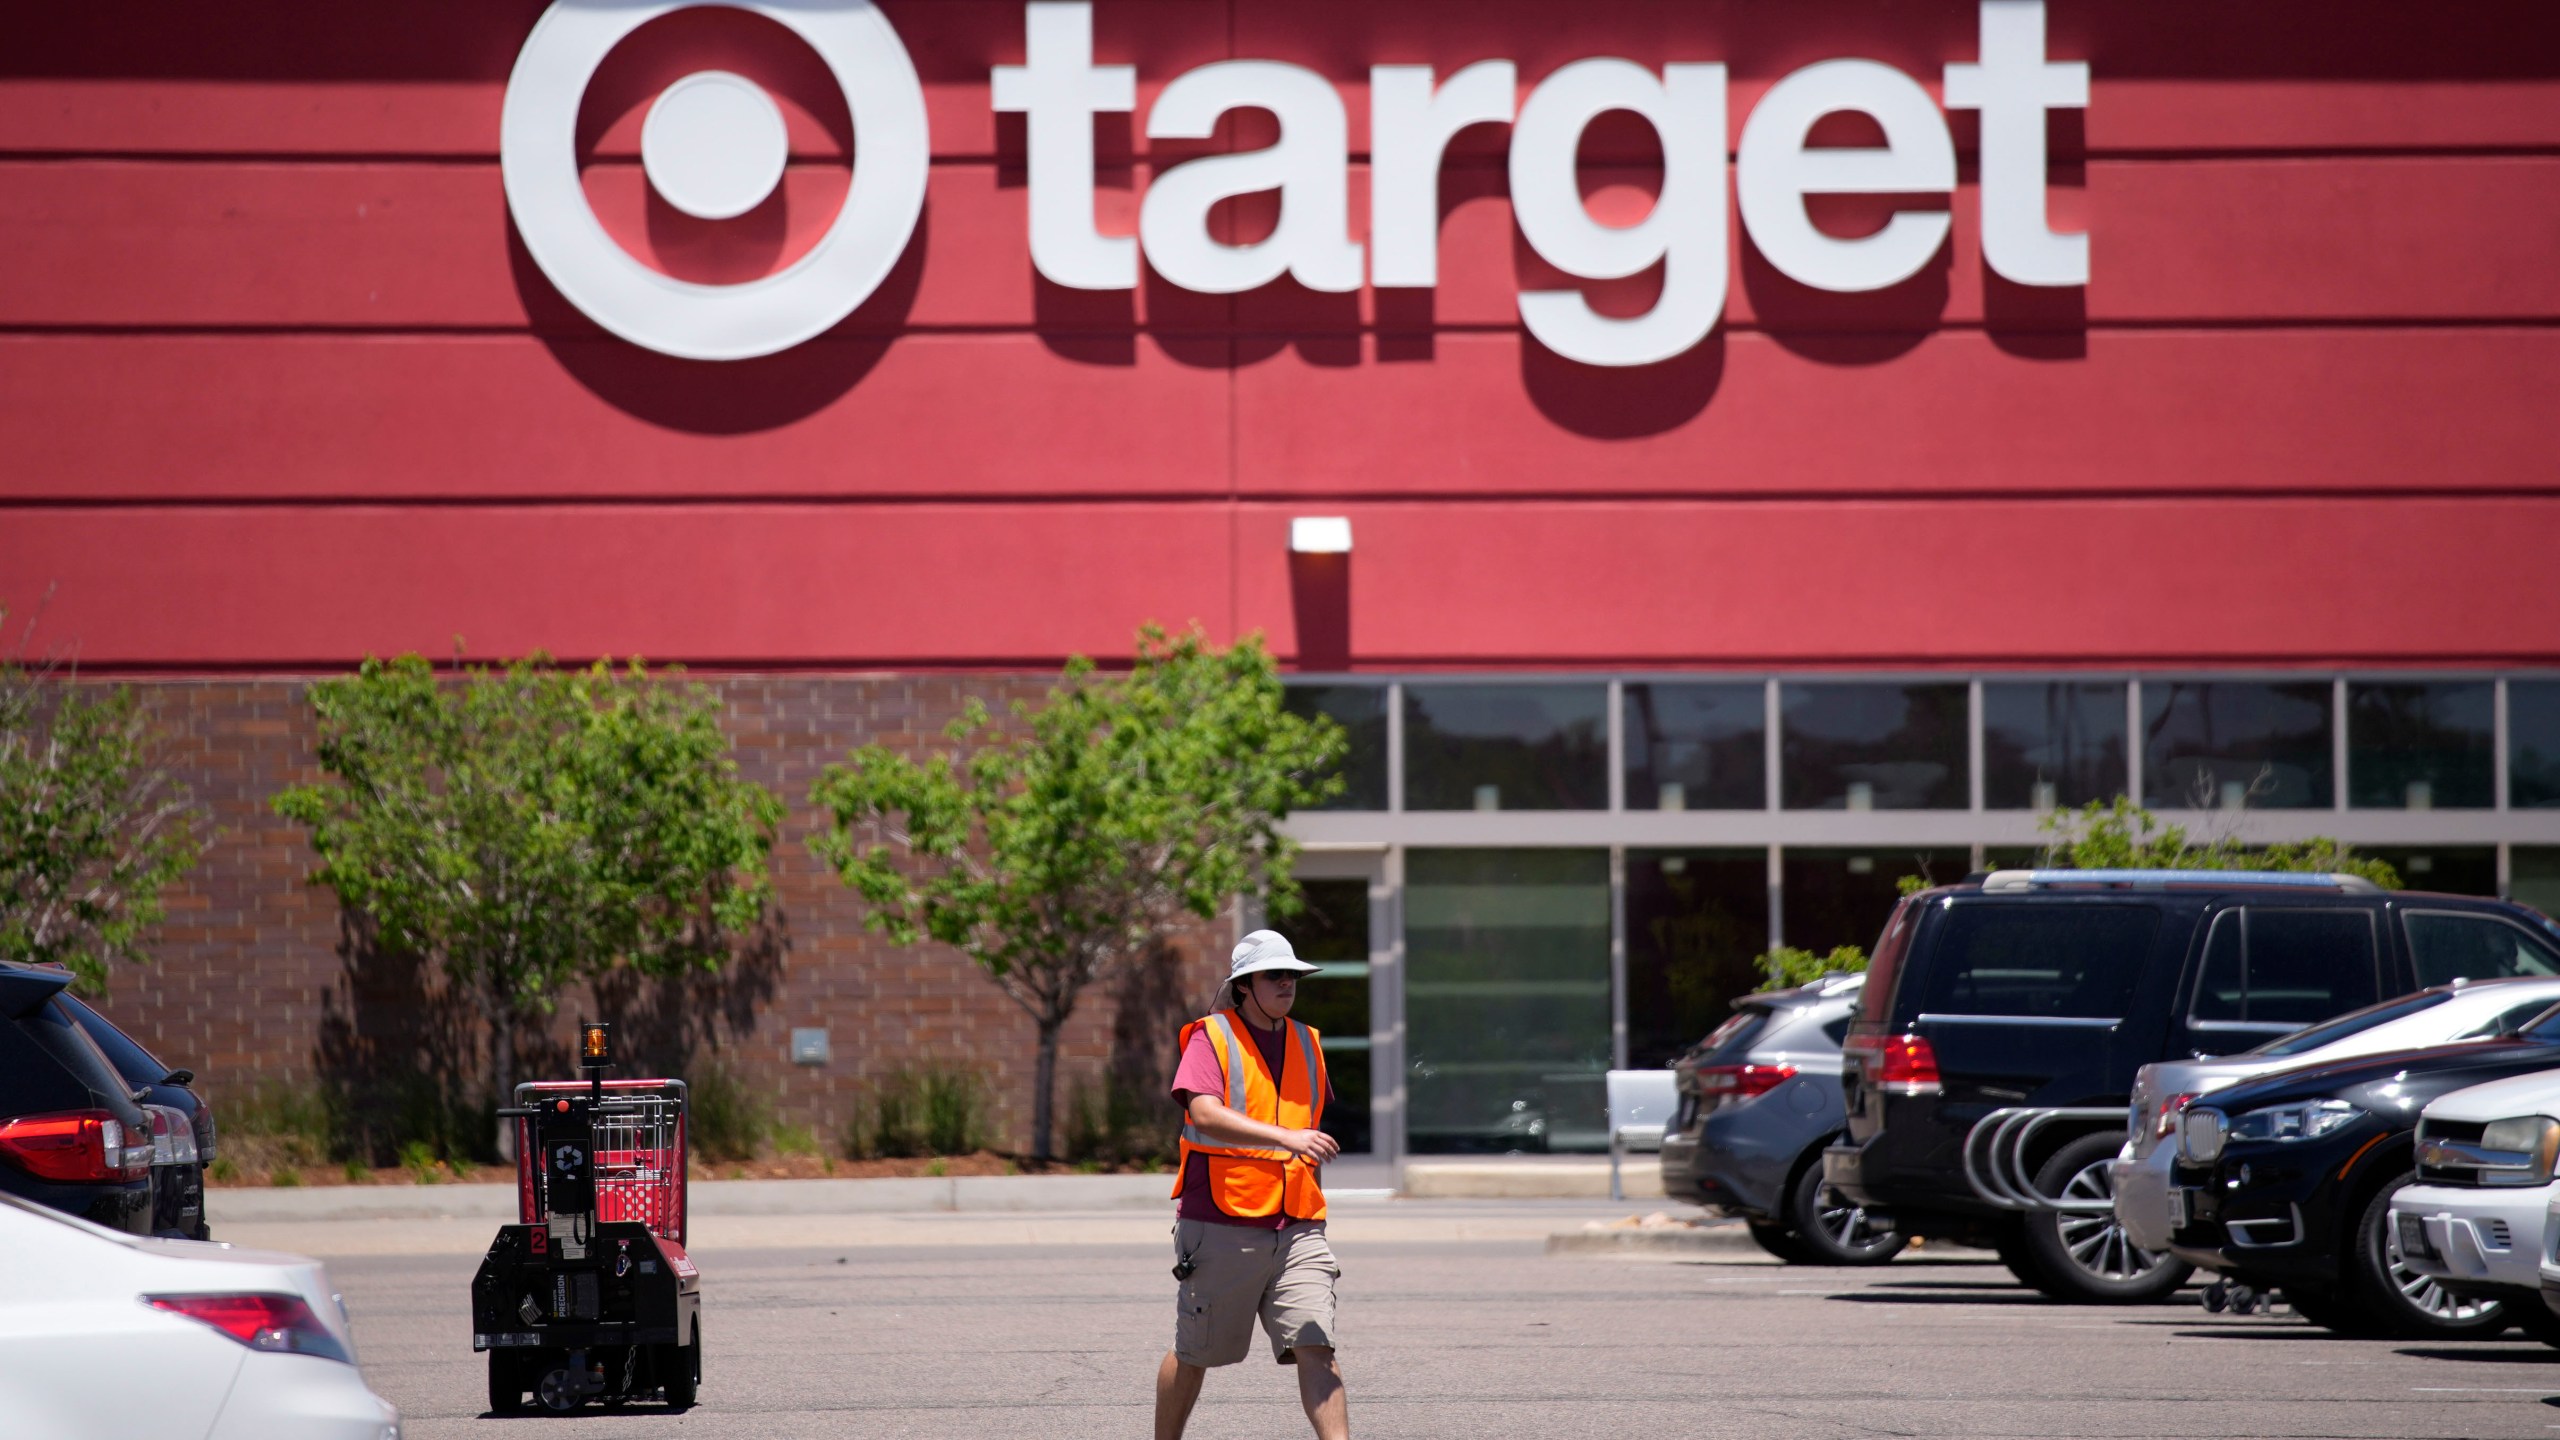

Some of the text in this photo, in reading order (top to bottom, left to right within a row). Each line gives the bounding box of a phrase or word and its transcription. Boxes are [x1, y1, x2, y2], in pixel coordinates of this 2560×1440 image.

[991, 1, 2090, 367] target
[532, 1231, 545, 1249] 2
[557, 1274, 566, 1318] PRECISION
